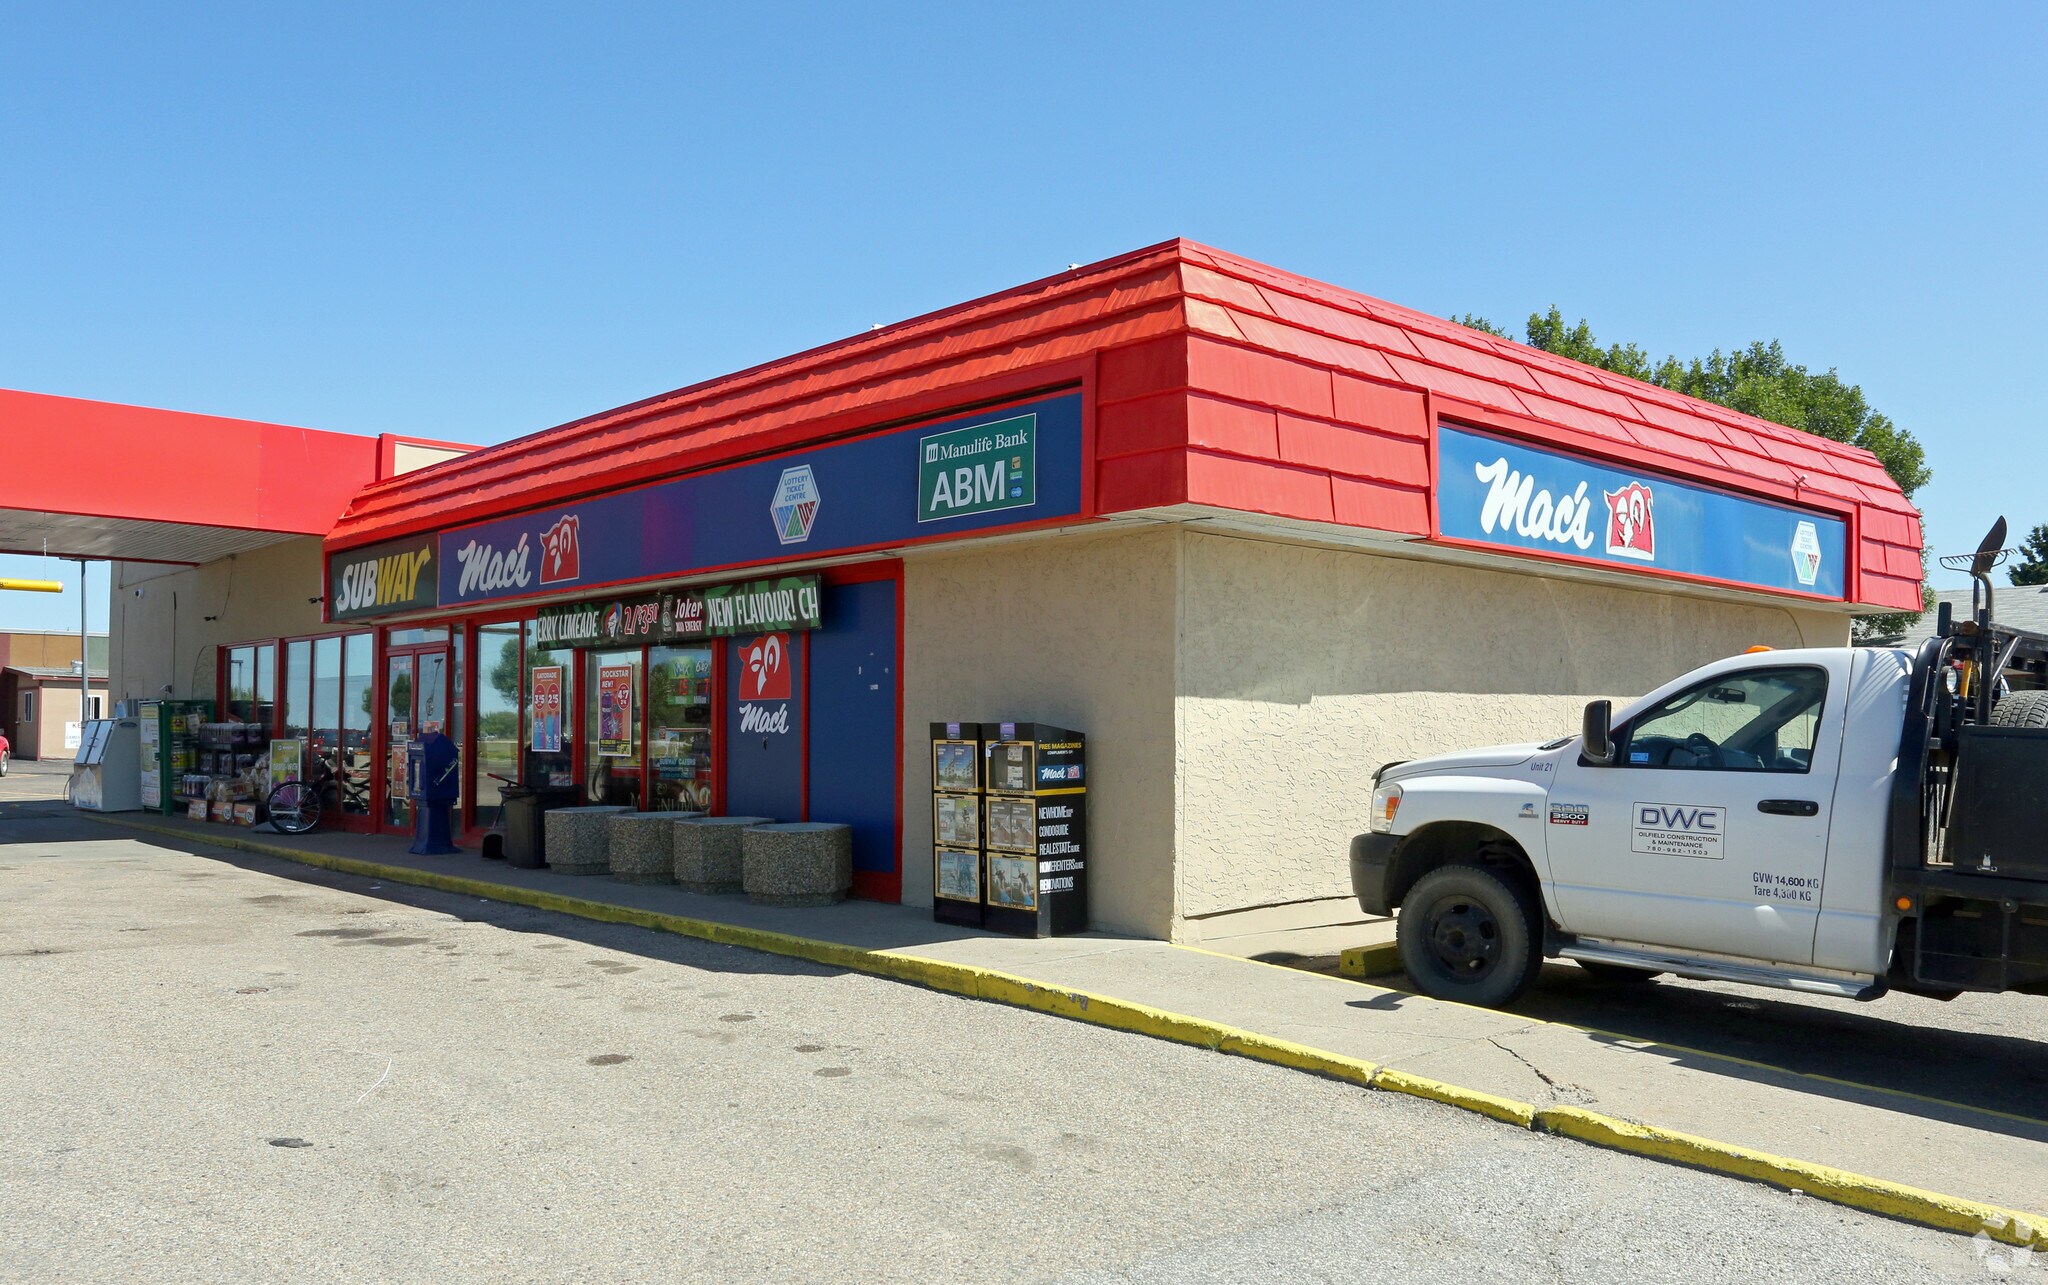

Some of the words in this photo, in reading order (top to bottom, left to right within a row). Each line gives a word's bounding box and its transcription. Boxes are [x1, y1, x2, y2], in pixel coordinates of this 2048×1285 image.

[940, 438, 993, 461] Manulife
[994, 429, 1028, 450] Bank
[785, 475, 808, 486] LOTTERY
[929, 460, 1006, 512] ABM
[787, 484, 804, 493] TICKET
[785, 492, 806, 502] CENTRE
[1475, 457, 1594, 550] Mac's
[457, 533, 531, 596] Mac's
[336, 545, 431, 614] SUBWAY
[559, 611, 600, 640] LIMEADE
[675, 598, 703, 619] Joker
[707, 597, 734, 628] NEW
[735, 589, 797, 625] FLAVOUR!
[798, 587, 819, 619] CH
[536, 672, 557, 680] GATORADE
[602, 670, 629, 678] ROCKSTAR
[739, 703, 789, 735] Mac's
[1051, 742, 1082, 750] MAGAZINES
[1530, 762, 1544, 771] Unit
[1544, 762, 1553, 772] 21
[1550, 803, 1590, 813] RAM
[1552, 812, 1586, 820] 3500
[1640, 806, 1717, 830] DWC
[1638, 831, 1665, 840] OILFIELD
[1666, 834, 1718, 843] CONSTRUCTION
[1658, 840, 1704, 849] MAINTENANCE
[1647, 845, 1709, 856] 780-962-1503
[1753, 871, 1773, 884] GVW
[1775, 876, 1805, 887] 14,600
[1807, 878, 1819, 889] KG
[1754, 885, 1771, 897] Tare
[1799, 891, 1812, 901] KG
